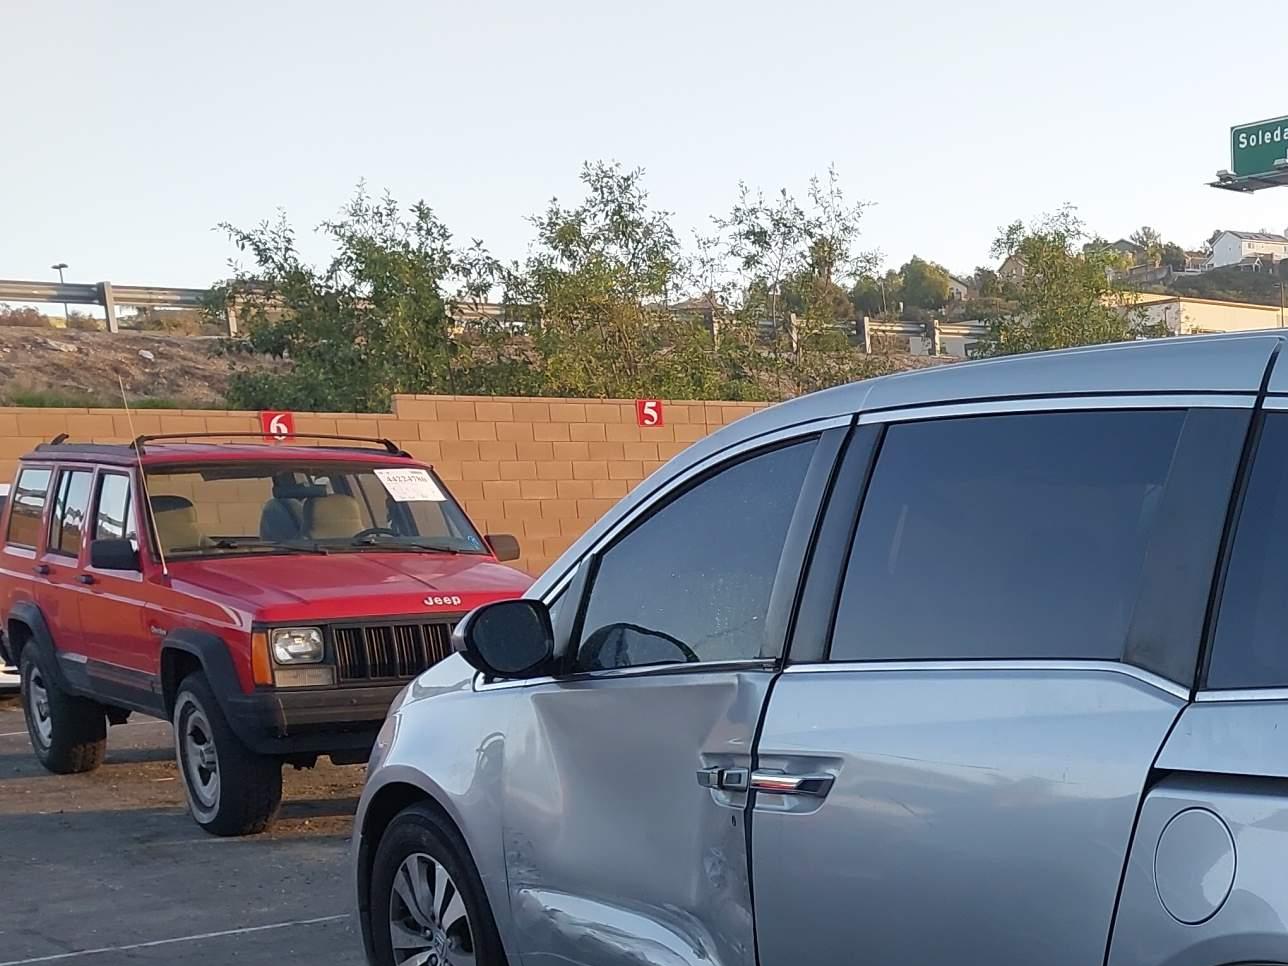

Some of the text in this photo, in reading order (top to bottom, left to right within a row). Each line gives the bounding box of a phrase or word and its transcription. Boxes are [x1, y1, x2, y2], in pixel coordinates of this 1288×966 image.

[643, 401, 658, 425] 5
[270, 414, 288, 440] 6
[423, 596, 461, 606] Jeep
